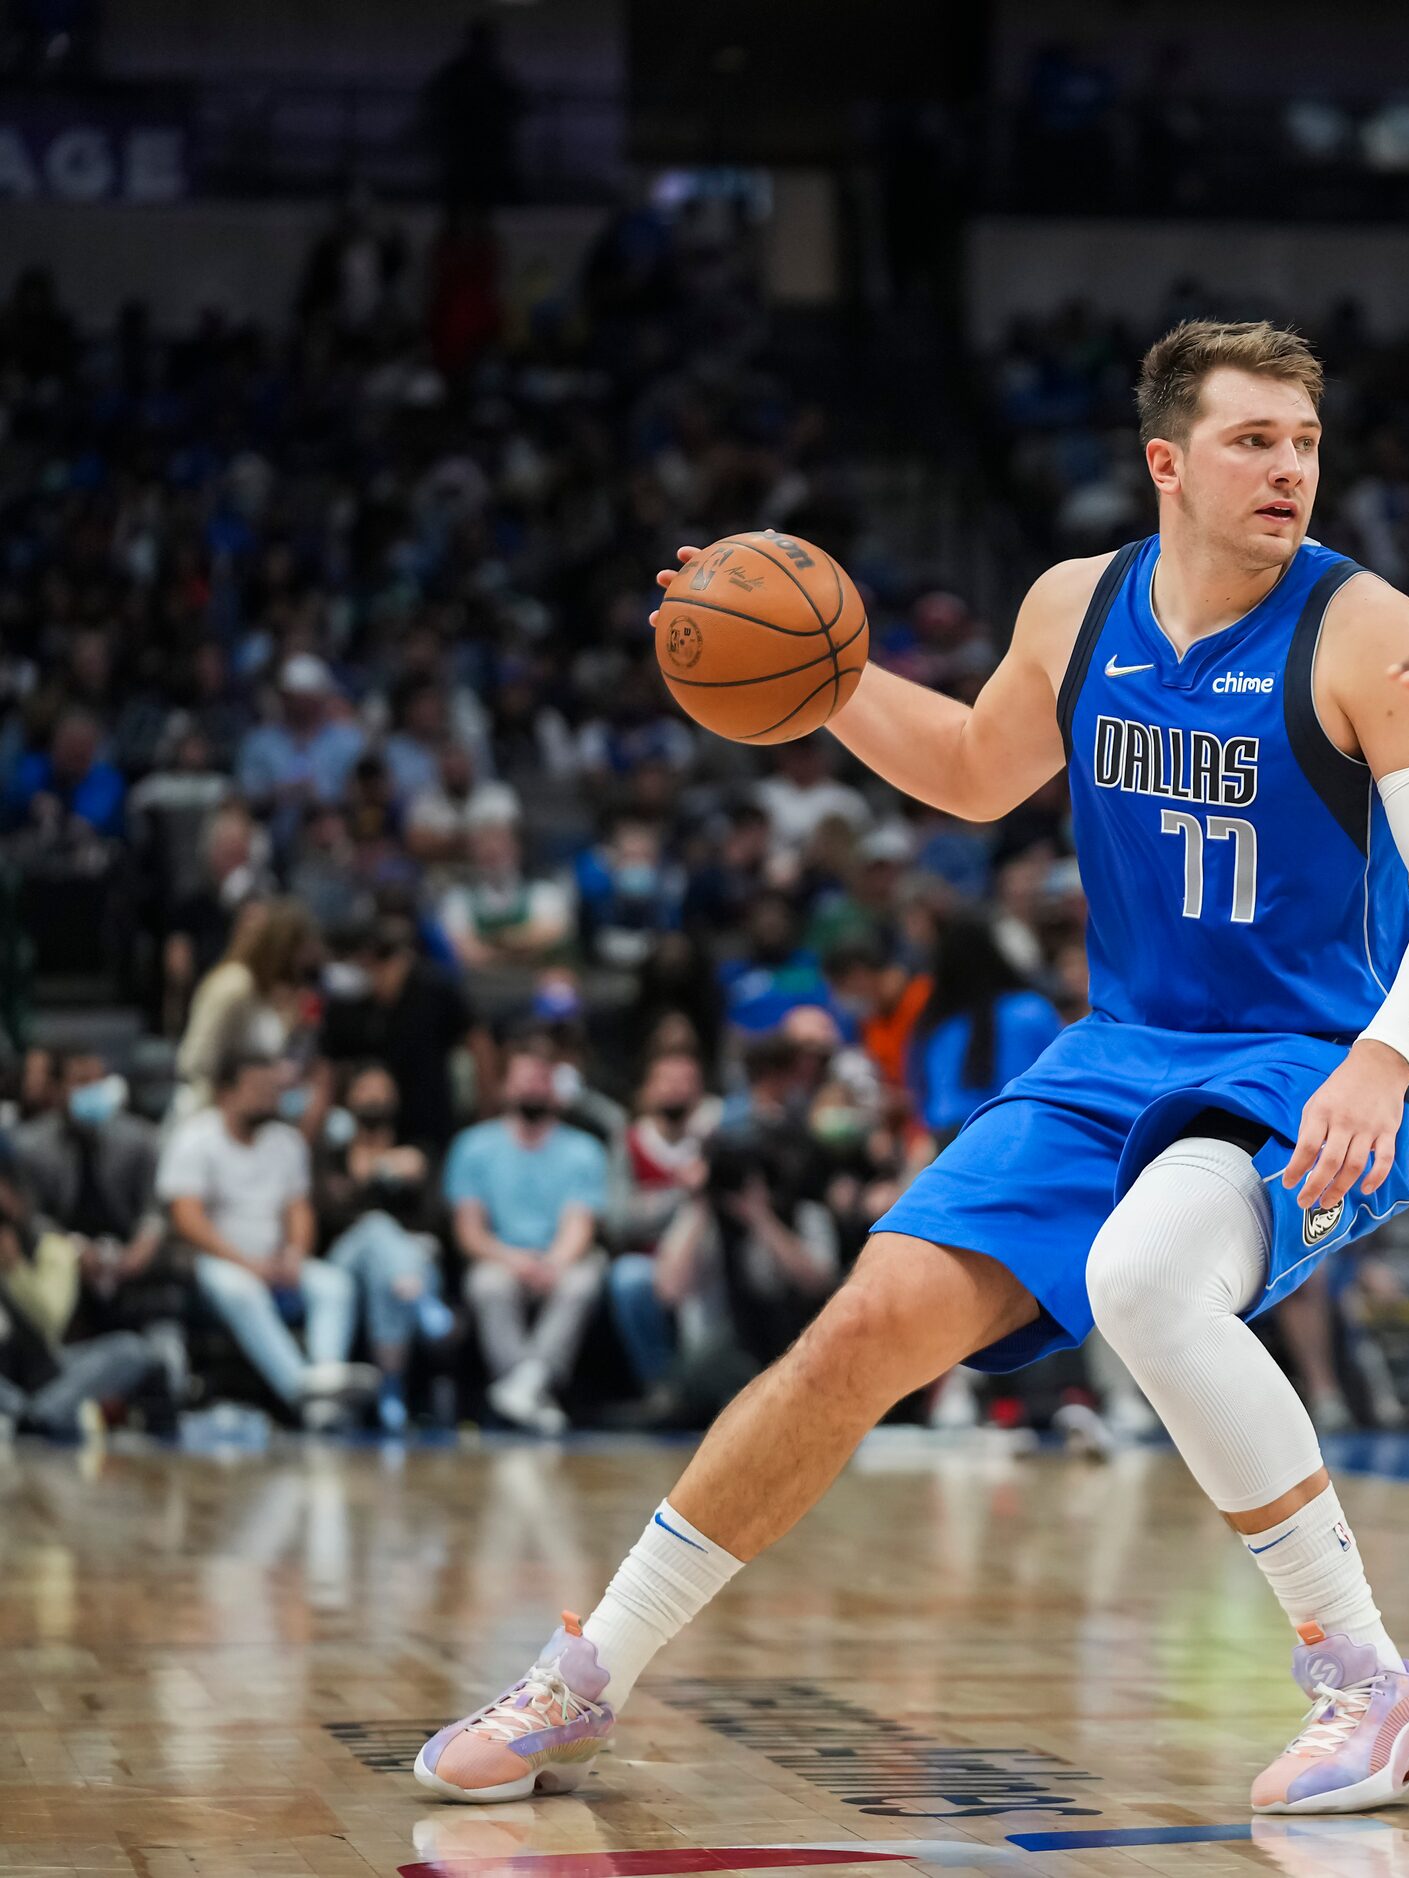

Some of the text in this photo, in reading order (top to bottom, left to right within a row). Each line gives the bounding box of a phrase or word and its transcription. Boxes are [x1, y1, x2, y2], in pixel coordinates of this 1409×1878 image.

[1211, 671, 1274, 694] chime
[1094, 714, 1260, 808] DALLAS
[1160, 808, 1258, 924] 77
